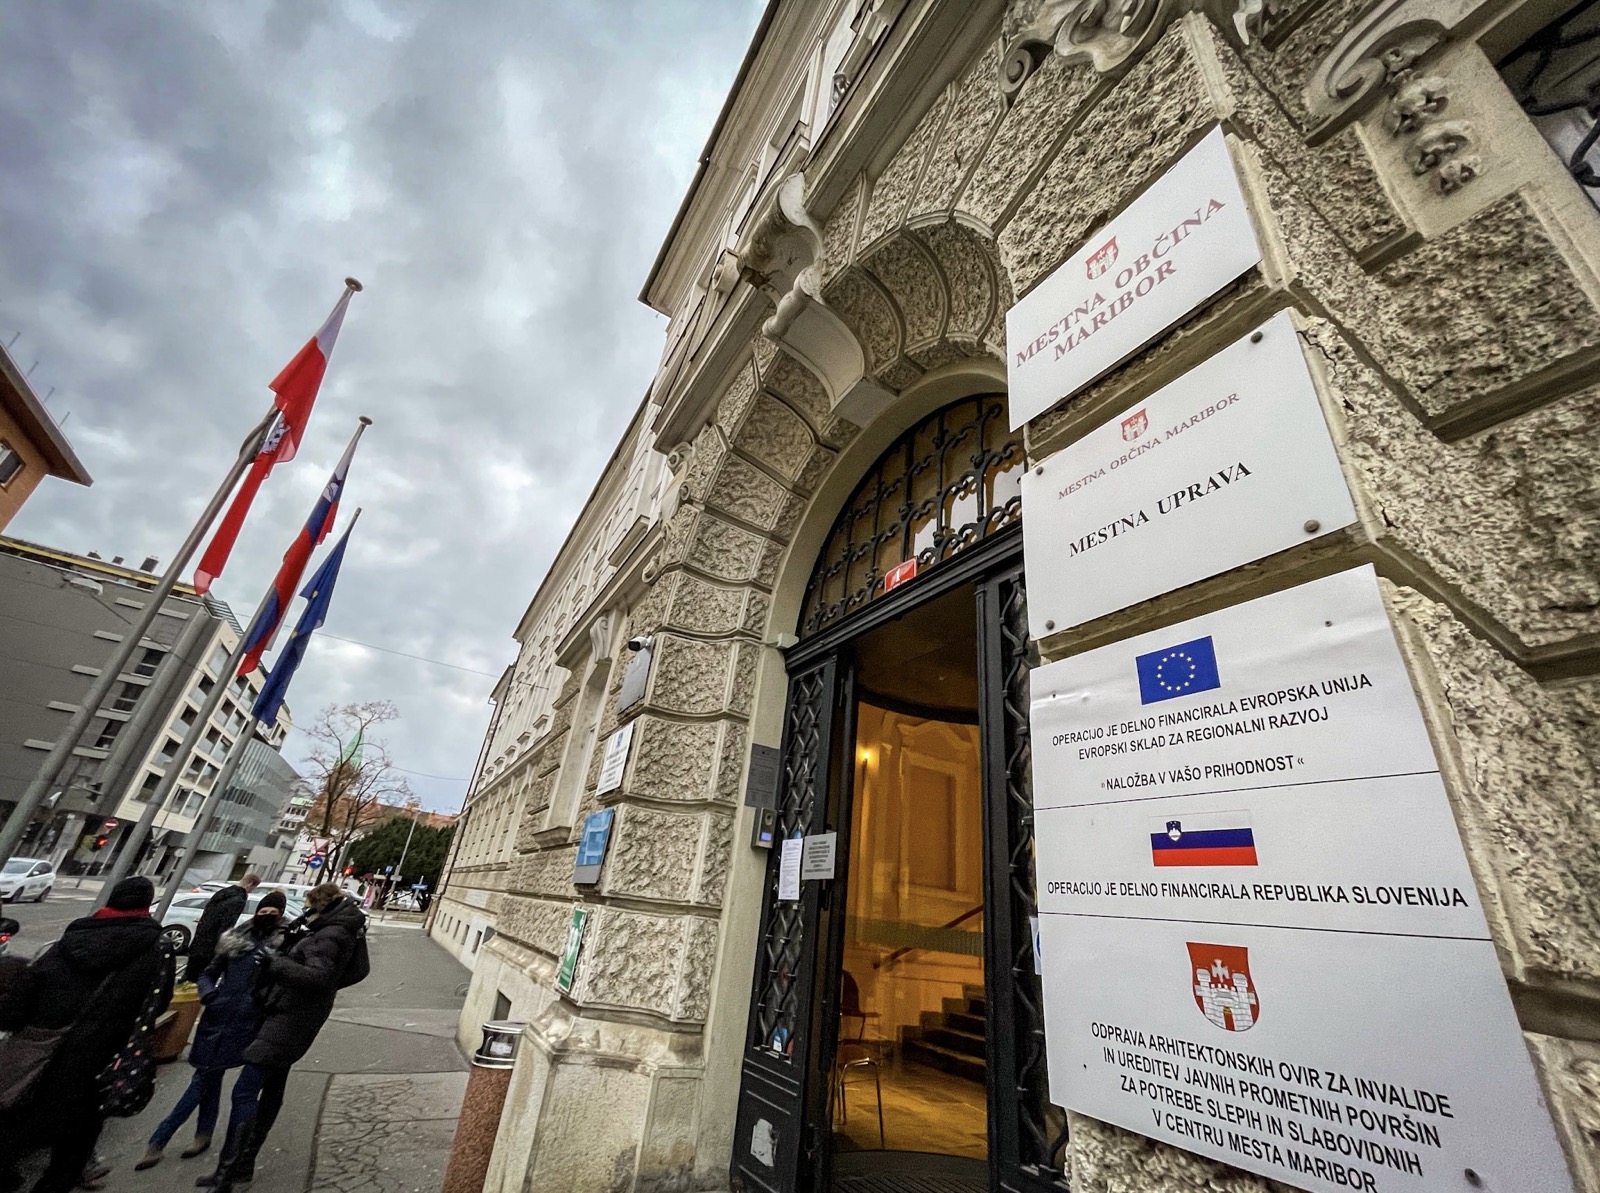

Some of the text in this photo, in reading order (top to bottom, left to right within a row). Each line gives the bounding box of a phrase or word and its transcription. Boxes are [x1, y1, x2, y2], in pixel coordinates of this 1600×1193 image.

[1016, 198, 1225, 368] MESTNA OBČINA
[1054, 260, 1176, 361] MARIBOR
[1058, 393, 1240, 499] MESTNA OBČINA MARIBOR
[1069, 462, 1252, 557] MESTNA UPRAVA
[895, 567, 901, 582] 1
[1052, 673, 1372, 746] OPERACIJO JE DELNO FINANCIRALA EVROPSKA UNIJA
[1078, 706, 1329, 760] EVROPSKI SKLAD ZA REGIONALNI RAZVOJ
[1158, 772, 1166, 785] V
[1168, 765, 1201, 783] VAŠO
[1047, 882, 1469, 907] OPERACIJO JE DELNO FINANCIRALA REPUBLIKA SLOVENIJA
[1091, 1022, 1455, 1118] ODPRAVA ARHITEKTONSKIH OVIR ZA INVALIDE
[1104, 1047, 1441, 1148] IN UREDITEV JAVNIH PROMETNIH POVRŠIN
[1121, 1075, 1424, 1177] ZA POTREBE SLEPIH IN SLABOVIDNIH
[1152, 1109, 1378, 1193] V CENTRU MESTA MARIBOR
